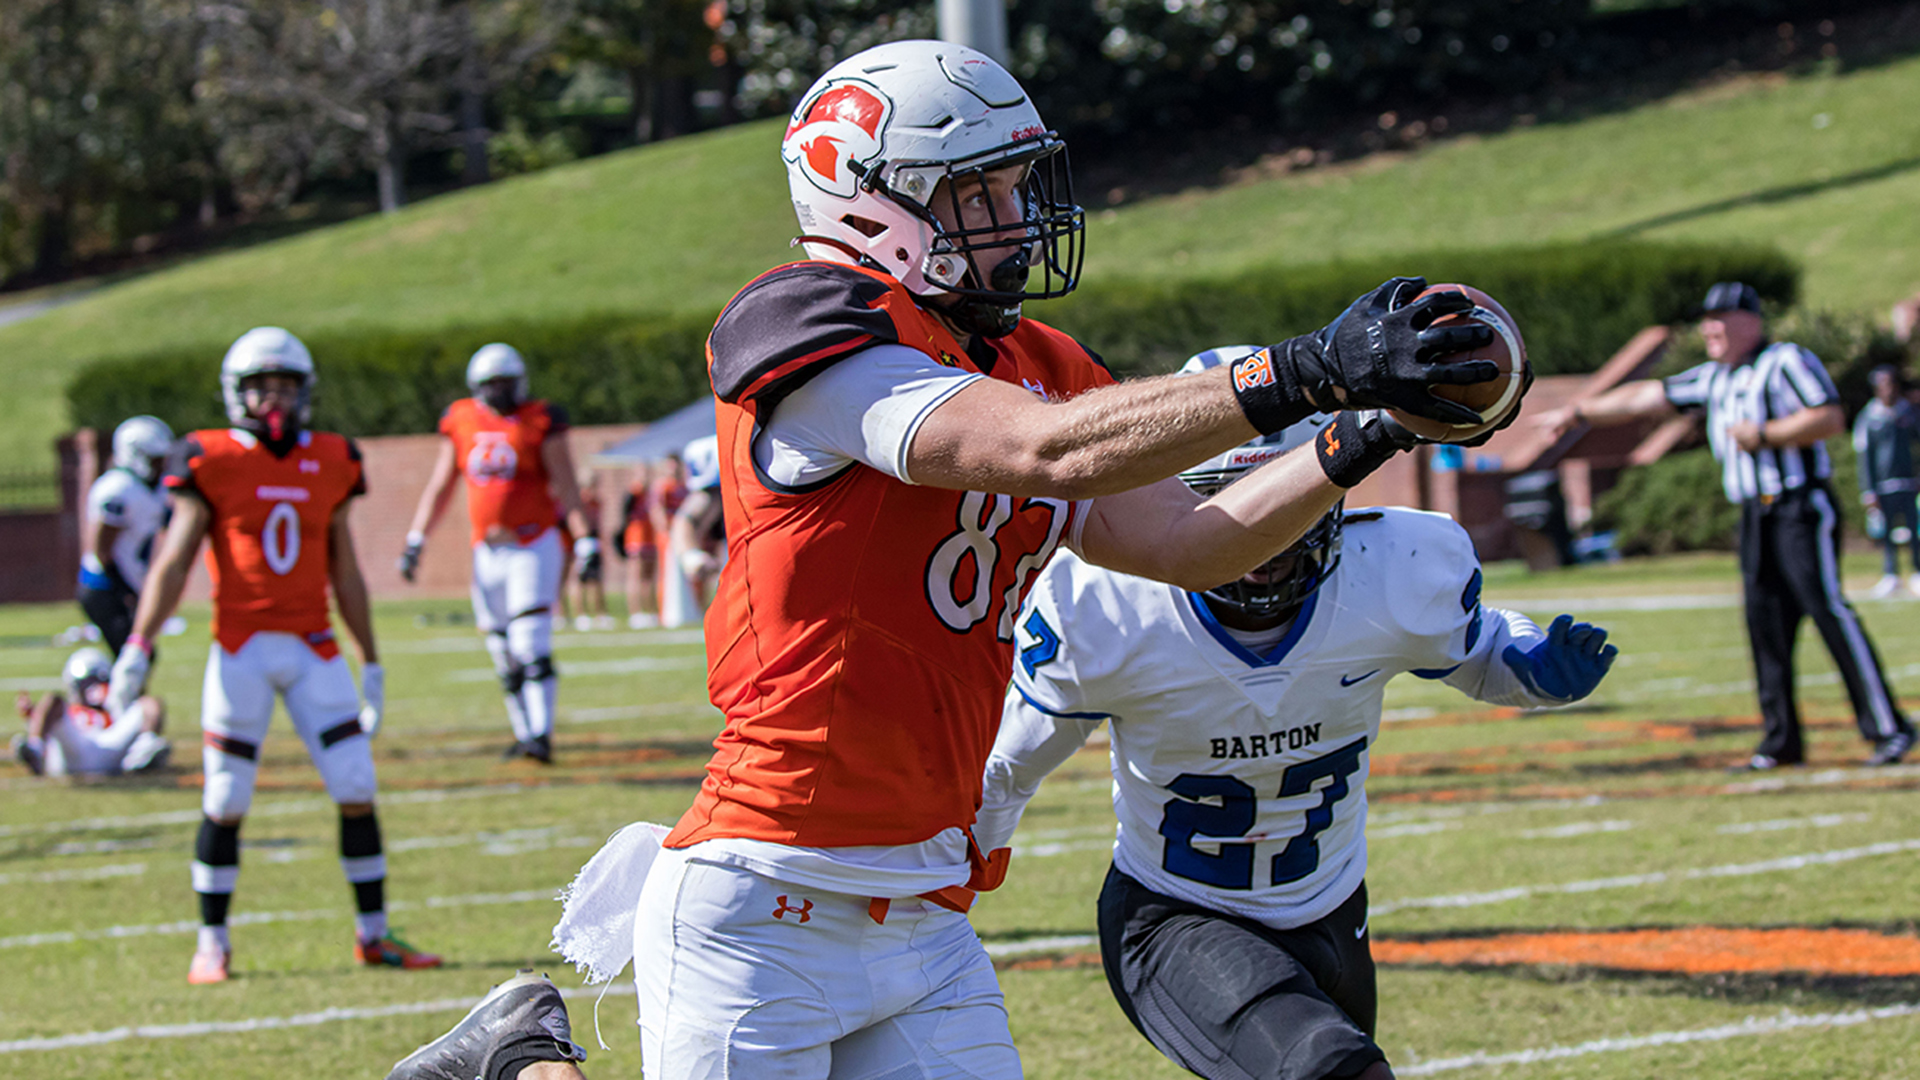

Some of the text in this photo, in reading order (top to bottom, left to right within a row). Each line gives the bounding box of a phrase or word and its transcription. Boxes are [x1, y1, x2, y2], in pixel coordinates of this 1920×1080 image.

[262, 501, 301, 576] 0
[1210, 722, 1322, 759] BARTON
[1158, 735, 1368, 891] 27
